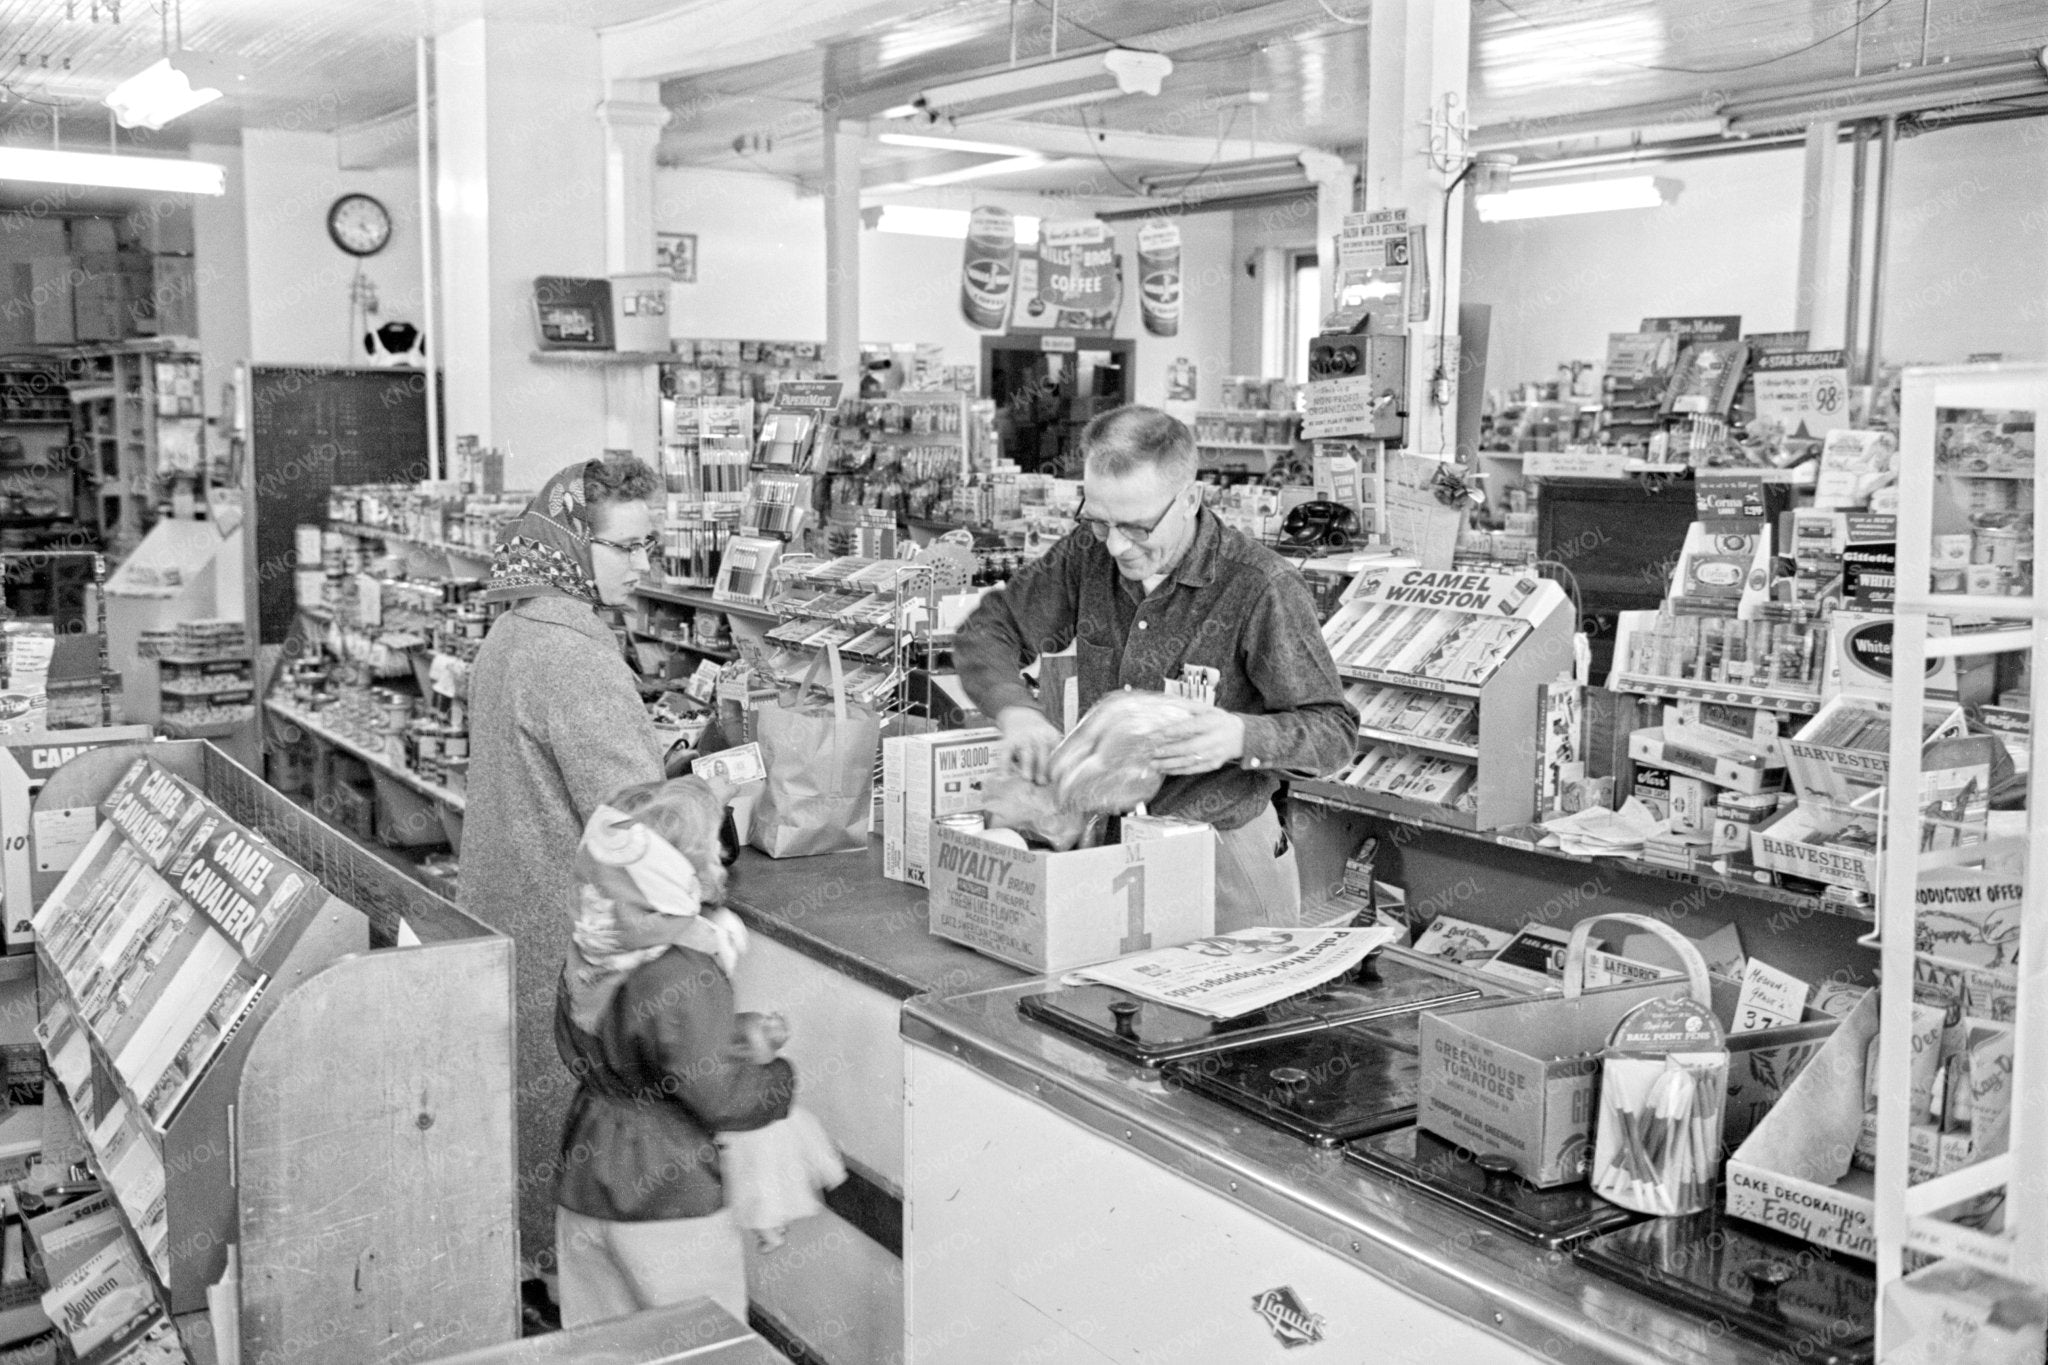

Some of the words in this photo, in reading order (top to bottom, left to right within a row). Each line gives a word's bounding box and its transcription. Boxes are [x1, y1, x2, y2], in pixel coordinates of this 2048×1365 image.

[1040, 244, 1070, 265] HILLS
[1050, 274, 1101, 294] COFFEE
[1758, 354, 1793, 368] 4-STAR
[1307, 404, 1365, 416] ORGANIZATION
[1816, 386, 1837, 412] 98
[1843, 551, 1895, 563] Gillette
[1402, 571, 1491, 591] CAMEL
[1385, 586, 1491, 609] WINSTON
[1855, 638, 1891, 655] White
[1351, 669, 1379, 680] SALEM
[1393, 676, 1446, 691] CIGARETTES
[939, 750, 958, 771] WIN
[140, 769, 186, 821] CAMEL
[112, 792, 168, 858] CAVALIER
[6, 836, 25, 851] 10
[213, 831, 275, 896] CAMEL
[937, 842, 1013, 886] ROYALTY
[1762, 839, 1865, 874] HARVESTER
[1666, 870, 1700, 885] LIFE
[179, 857, 257, 944] CAVALIER
[1986, 884, 2023, 903] OFFER
[1112, 864, 1152, 956] 1
[1807, 899, 1846, 916] LIFE
[1306, 931, 1350, 959] Pabst
[1271, 951, 1311, 975] Work
[1604, 957, 1615, 971] LA
[1203, 967, 1276, 992] Stoppage
[1626, 1032, 1651, 1042] BALL
[1653, 1031, 1683, 1041] POINT
[1684, 1030, 1711, 1041] PENS
[1434, 1038, 1526, 1091] GREENHOUSE
[1442, 1057, 1515, 1102] TOMATOES
[1732, 1173, 1769, 1194] CAKE
[1775, 1185, 1866, 1225] DECORATING
[1762, 1197, 1813, 1241] Easy
[62, 1277, 119, 1319] Northern
